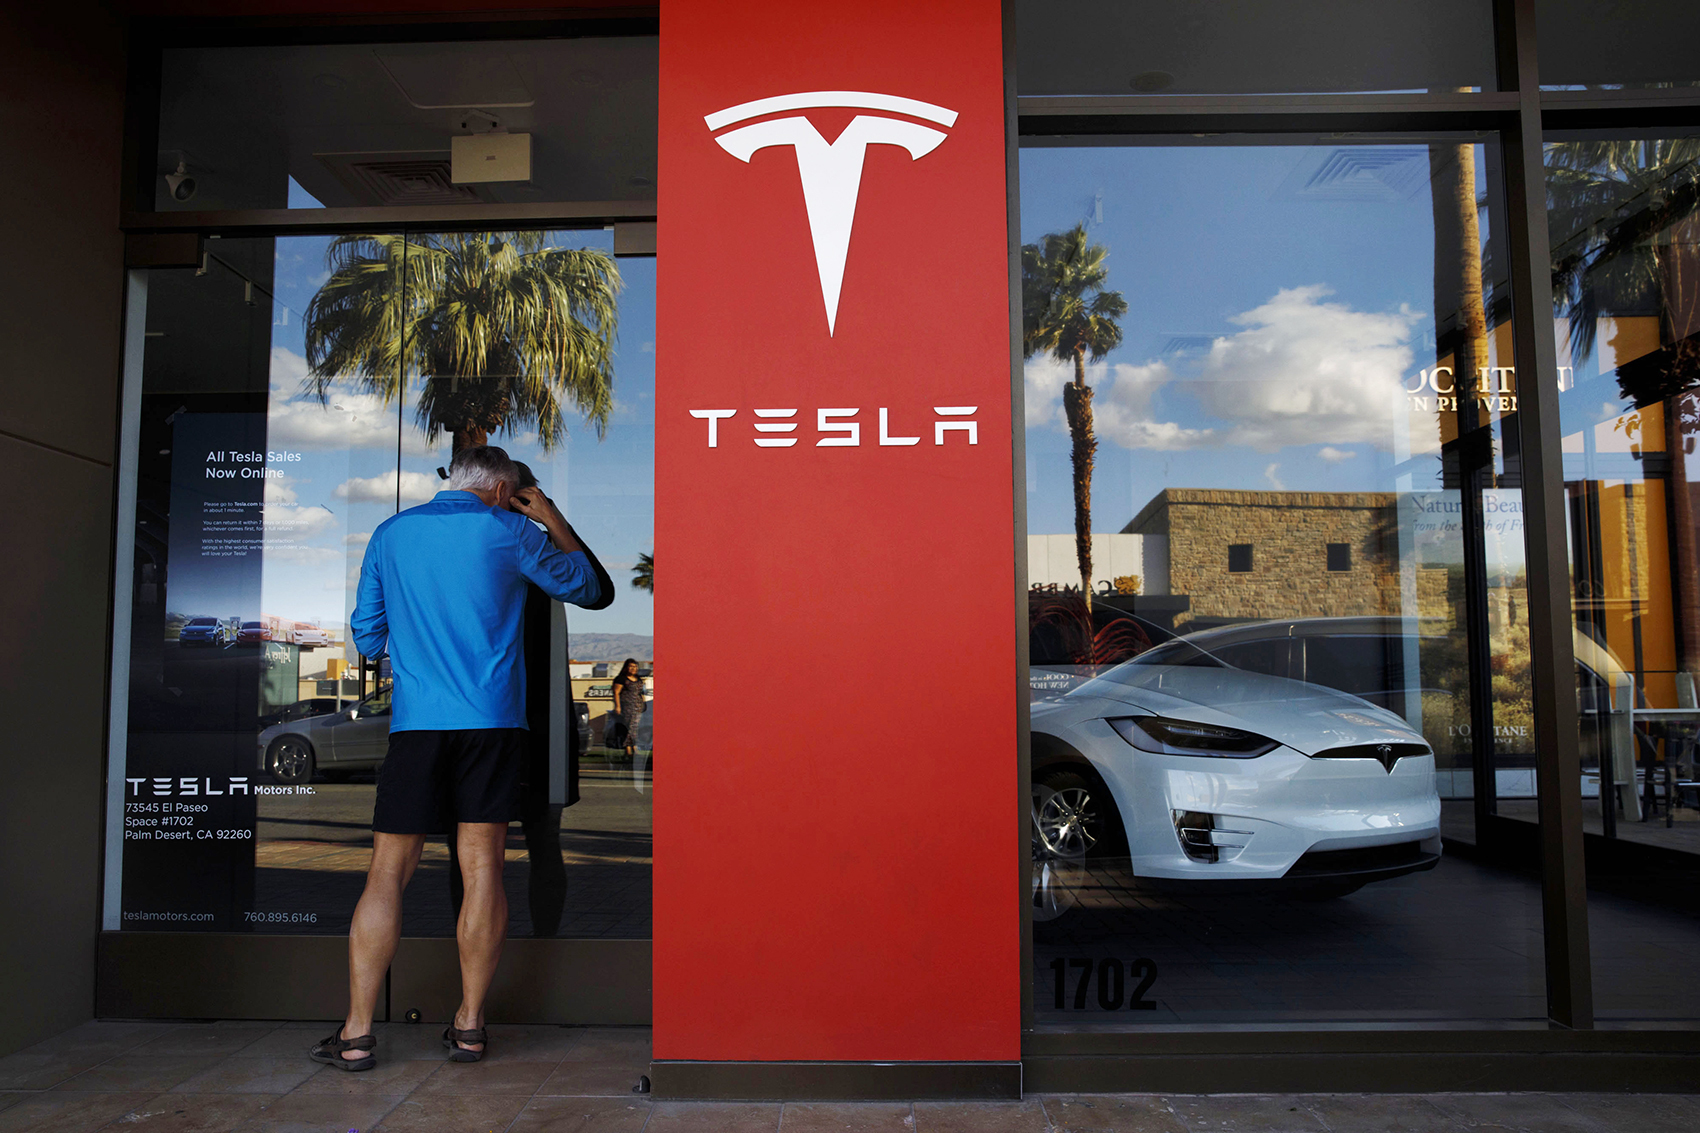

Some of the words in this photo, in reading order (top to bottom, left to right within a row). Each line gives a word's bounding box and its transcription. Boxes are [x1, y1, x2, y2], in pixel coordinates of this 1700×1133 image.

[689, 406, 978, 448] TESLA
[206, 451, 224, 462] All
[229, 451, 262, 462] Tesla
[267, 451, 301, 462] Sales
[206, 467, 236, 478] Now
[240, 467, 284, 478] Online
[1412, 495, 1462, 513] Natur
[126, 777, 248, 796] TESLA
[254, 786, 293, 795] Motors
[296, 786, 316, 794] Inc.
[126, 803, 159, 813] 73545
[162, 803, 172, 813] El
[176, 803, 208, 813] Paseo
[125, 816, 158, 827] Space
[161, 816, 193, 826] #1702
[125, 830, 151, 840] Palm
[155, 830, 193, 840] Desert,
[196, 830, 213, 839] CA
[216, 830, 251, 839] 92260
[123, 911, 214, 921] teslamotors.com
[244, 912, 317, 923] 760.895.6146
[1050, 957, 1157, 1011] 1702
